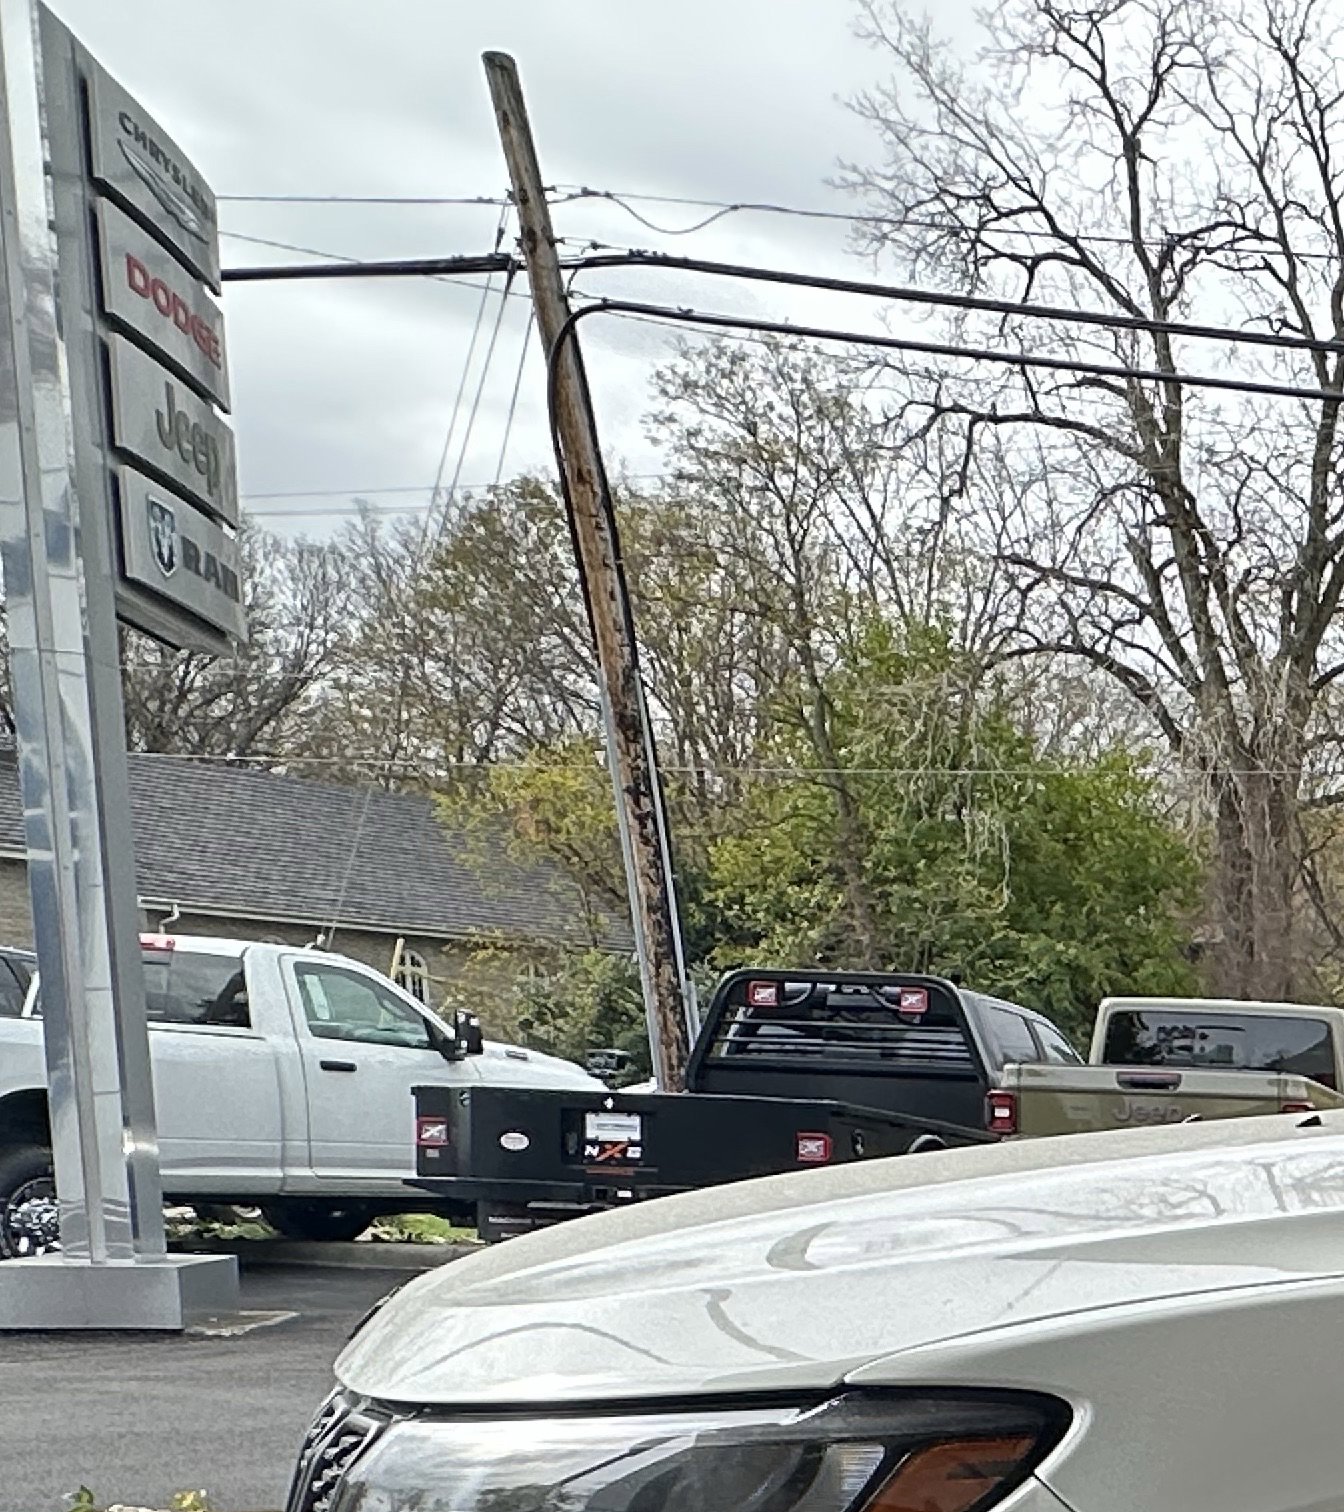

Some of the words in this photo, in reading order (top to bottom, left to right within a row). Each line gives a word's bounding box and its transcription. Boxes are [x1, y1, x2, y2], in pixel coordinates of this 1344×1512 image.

[126, 252, 221, 371] DODGE
[155, 380, 220, 498] Jeep
[181, 535, 240, 603] RAM
[1112, 1094, 1182, 1124] Jeep
